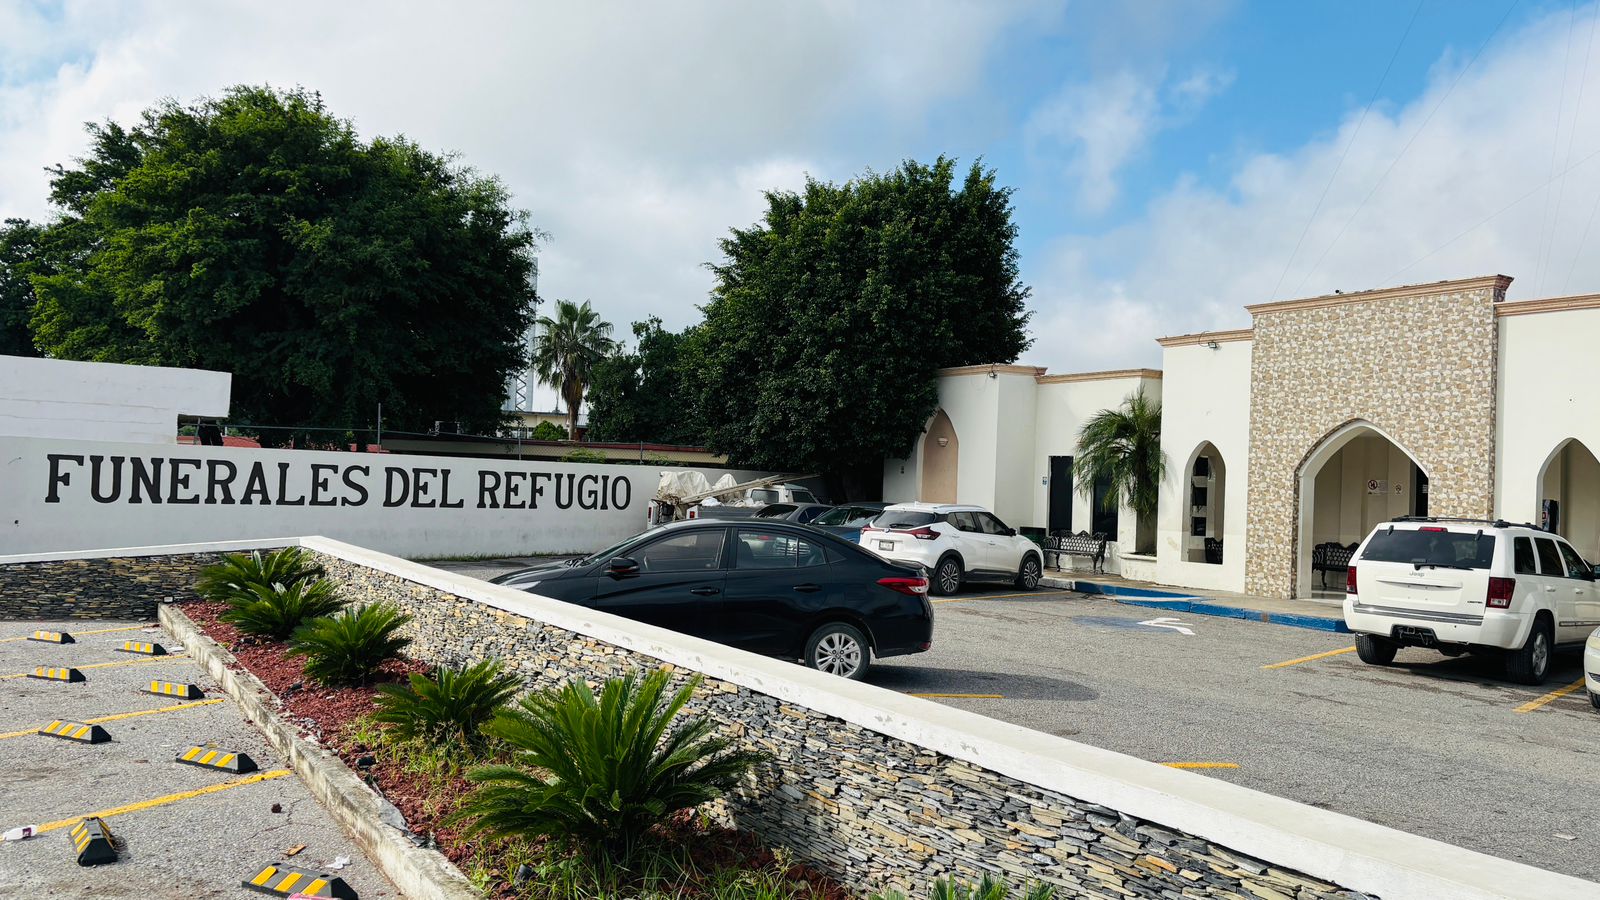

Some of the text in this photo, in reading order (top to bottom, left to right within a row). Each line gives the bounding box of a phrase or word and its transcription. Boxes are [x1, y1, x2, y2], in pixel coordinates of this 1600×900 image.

[45, 453, 632, 511] FUNERALES DEL REFUGIO
